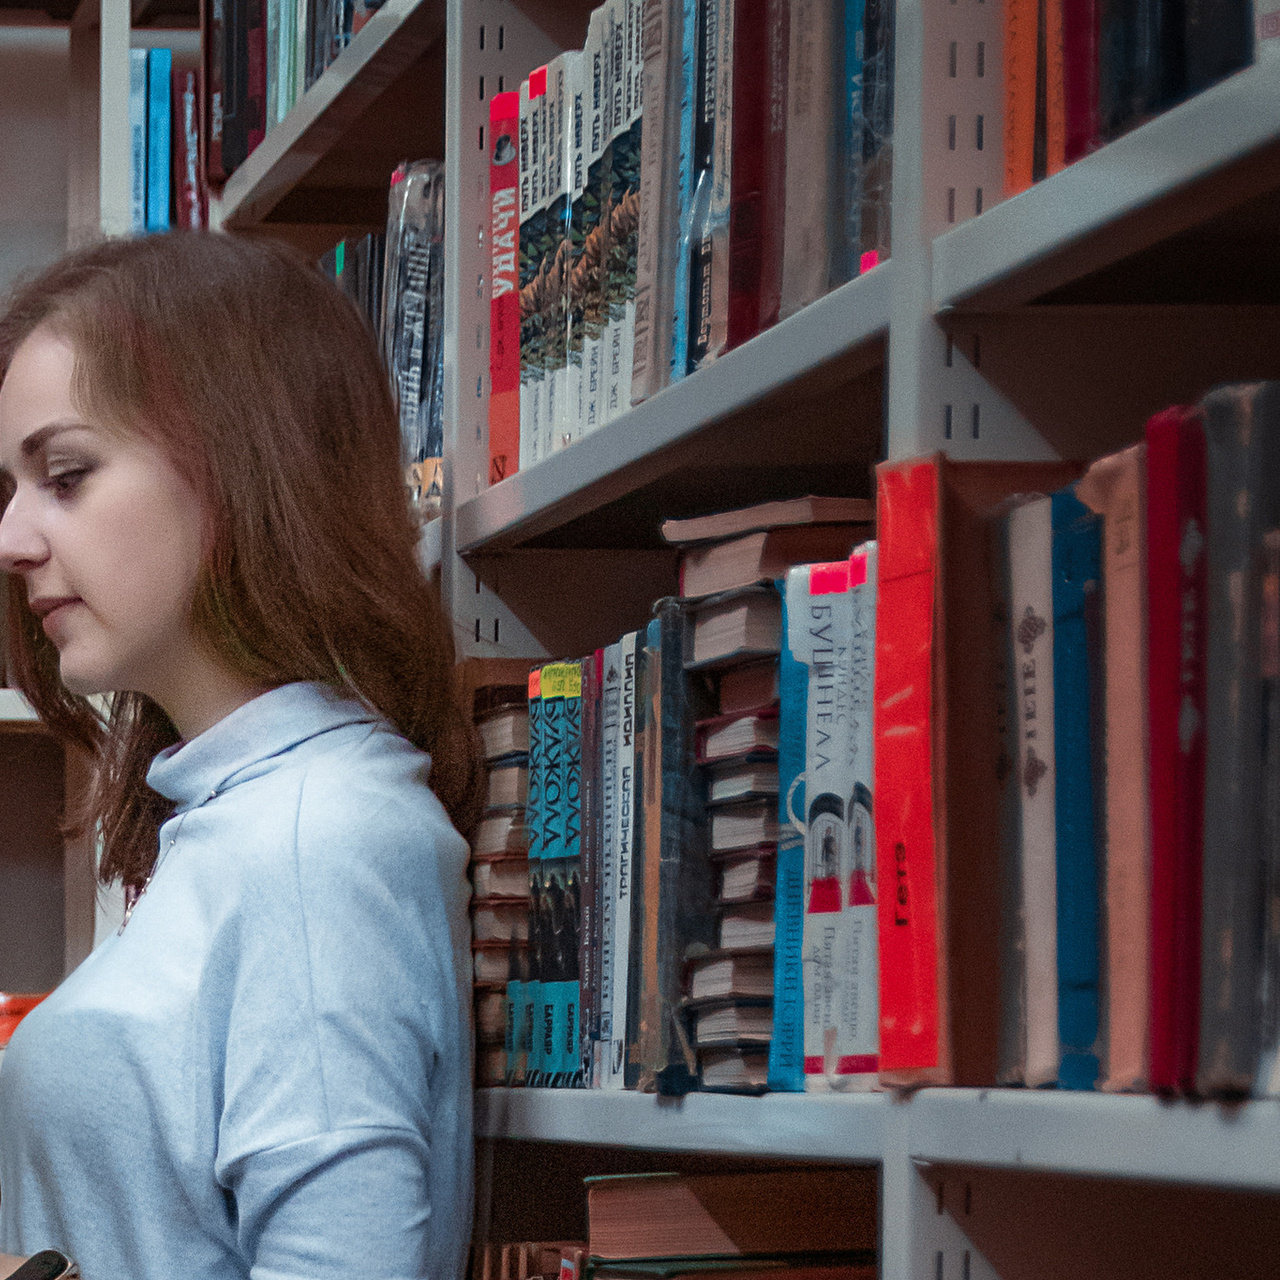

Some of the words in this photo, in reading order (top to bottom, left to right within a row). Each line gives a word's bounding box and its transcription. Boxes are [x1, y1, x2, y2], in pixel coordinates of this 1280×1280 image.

[593, 51, 601, 110] НАВЕРХ
[592, 114, 600, 154] ПУТЬ
[492, 186, 516, 298] УДАЧИ
[624, 651, 638, 747] ИДИЛЛИЯ
[807, 604, 833, 774] БУШНЕЛЛ
[620, 765, 635, 898] ТРАГИЧЕСКАЯ
